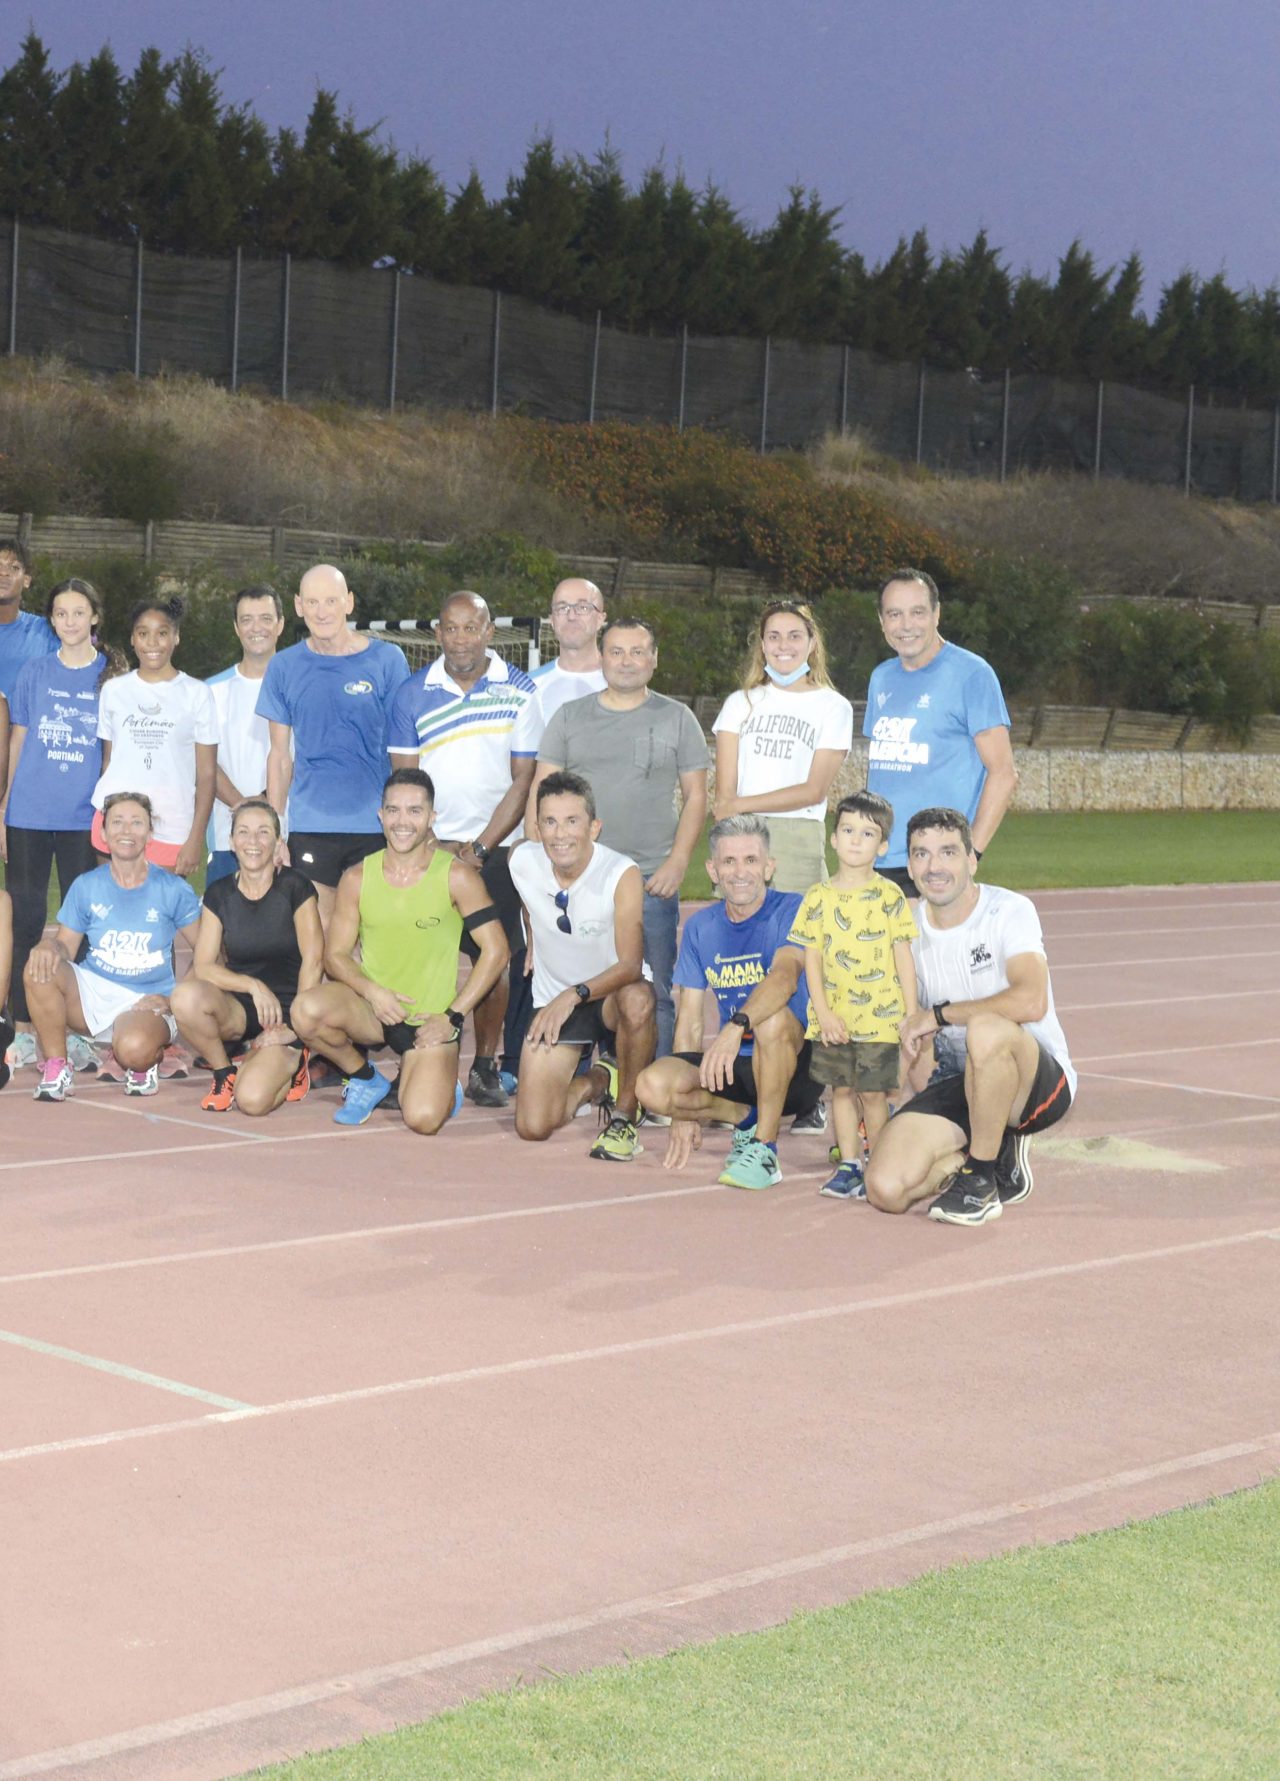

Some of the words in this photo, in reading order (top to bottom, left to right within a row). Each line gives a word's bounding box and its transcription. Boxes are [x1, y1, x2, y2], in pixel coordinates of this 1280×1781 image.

[740, 714, 816, 750] CALIFORNIA
[47, 750, 84, 763] PORTIMÃO
[754, 736, 795, 760] STATE
[99, 930, 152, 954] 42K
[720, 961, 765, 979] MAMA
